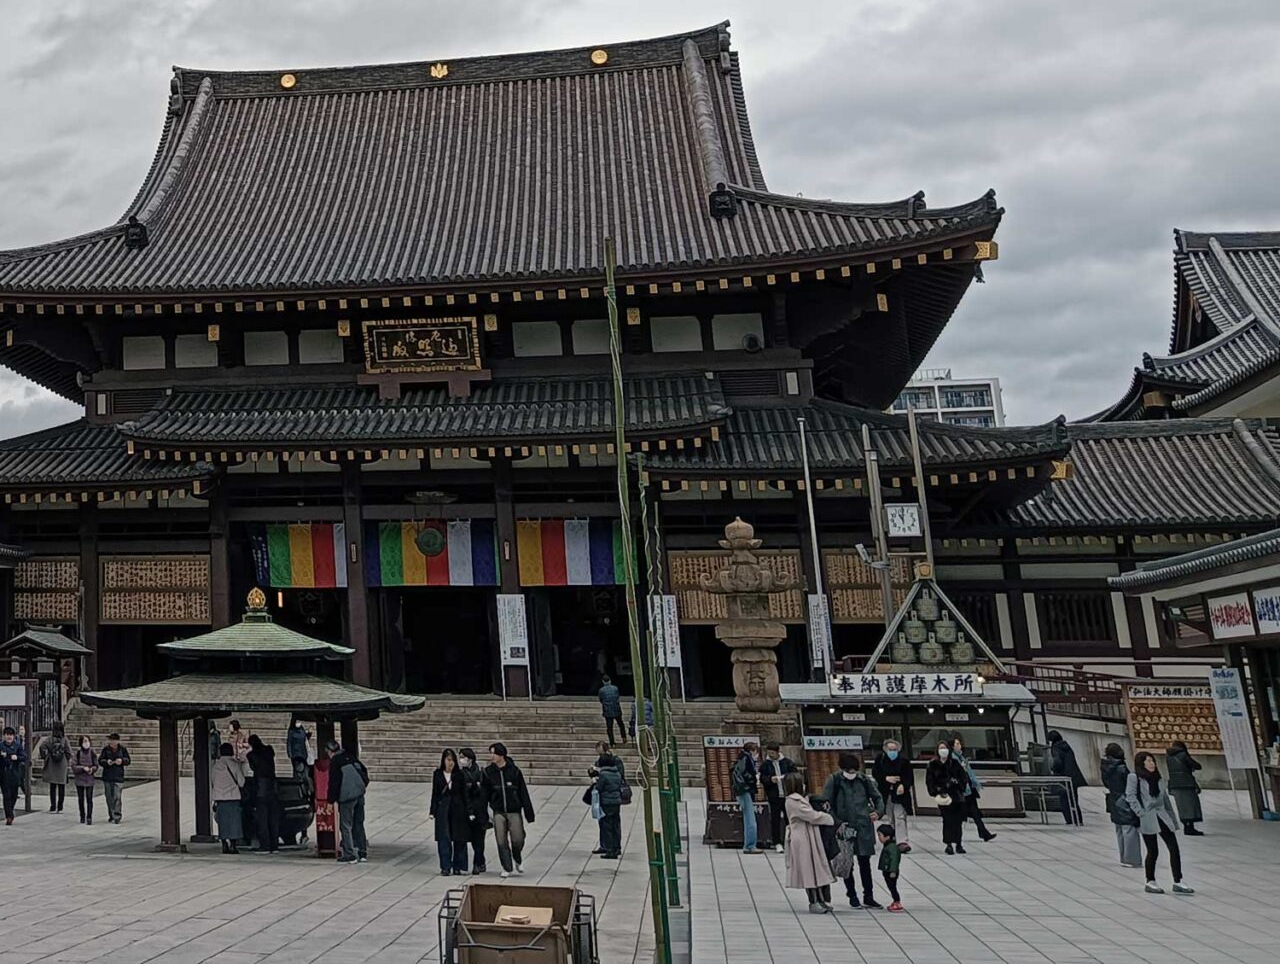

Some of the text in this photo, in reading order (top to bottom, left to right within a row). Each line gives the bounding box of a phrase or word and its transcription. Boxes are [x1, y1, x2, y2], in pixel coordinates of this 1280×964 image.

[837, 674, 974, 694] 奉納護摩木所
[818, 738, 850, 747] おみくじ
